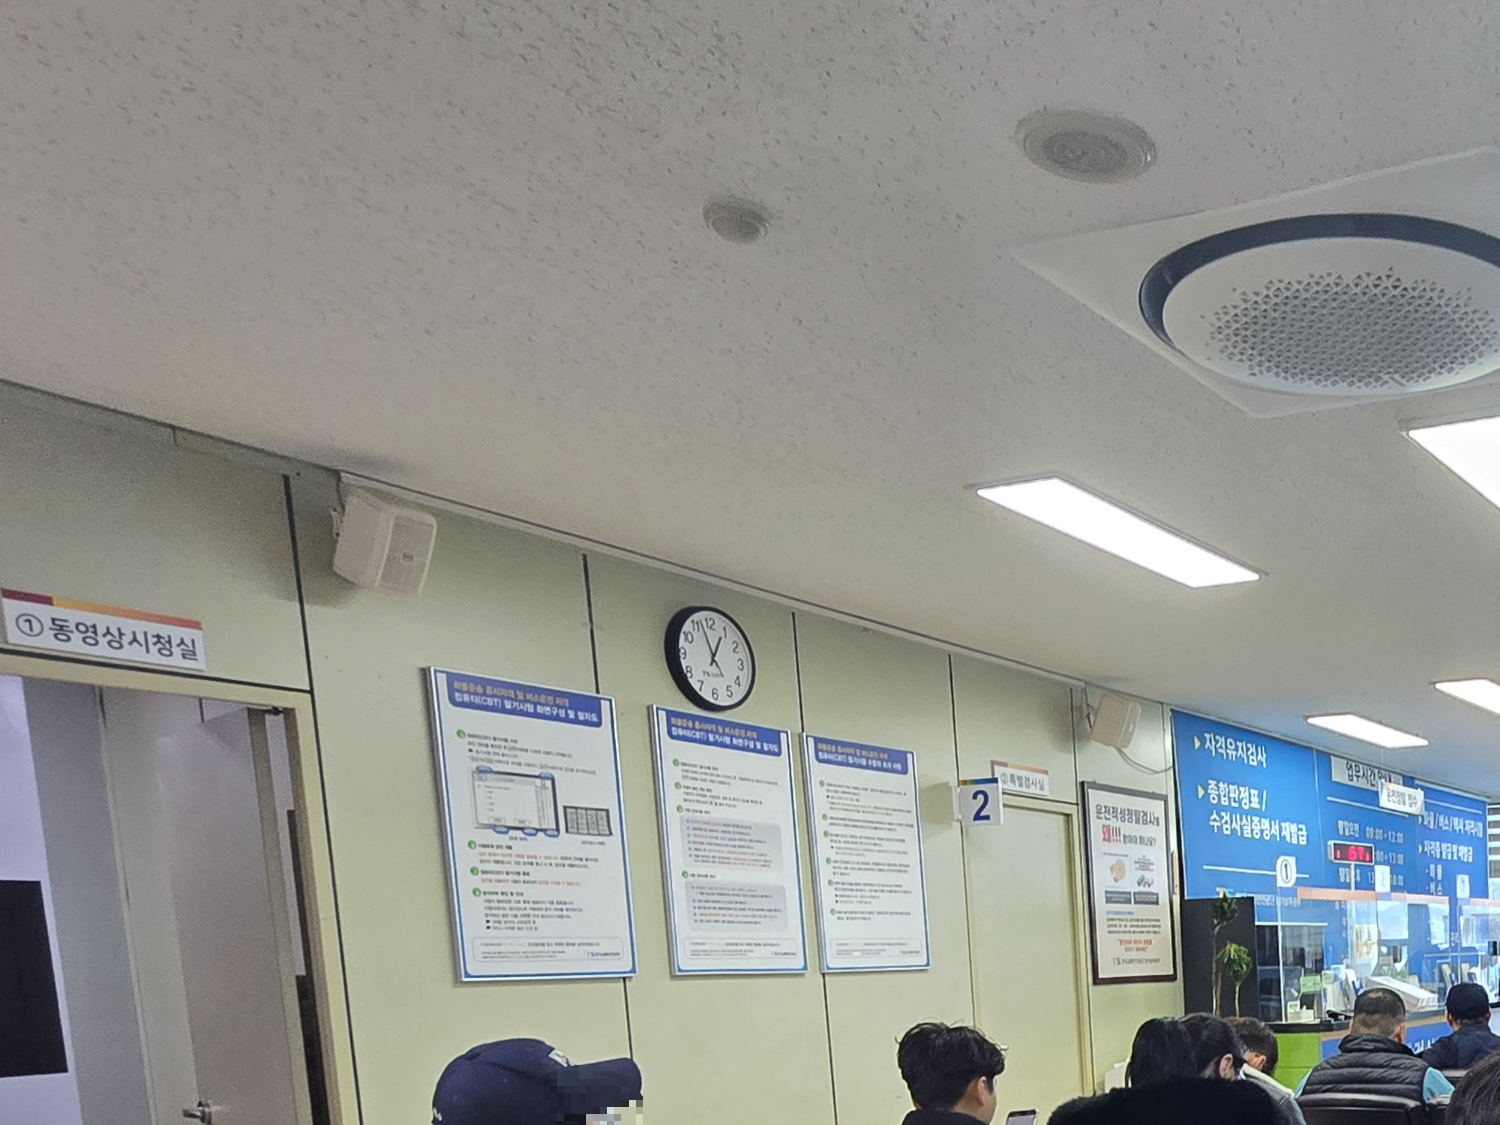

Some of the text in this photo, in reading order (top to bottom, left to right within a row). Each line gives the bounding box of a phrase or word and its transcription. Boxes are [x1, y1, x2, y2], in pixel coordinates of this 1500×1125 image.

[691, 619, 700, 633] 11
[705, 617, 716, 631] 12
[49, 616, 199, 662] 동영상시청실
[683, 630, 694, 644] 10
[723, 626, 727, 639] 1
[679, 646, 687, 660] 9
[732, 641, 739, 654] 2
[737, 658, 744, 671] 3
[685, 665, 693, 679] 8
[697, 679, 704, 692] 7
[734, 675, 741, 687] 4
[711, 687, 719, 701] 6
[726, 685, 733, 698] 5
[1204, 732, 1267, 768] 자격유지검사
[1346, 760, 1376, 787] 업무시간
[1009, 773, 1045, 791] 특별검사실
[972, 789, 991, 822] 2
[1209, 810, 1307, 846] 수검사실증명서 재발급
